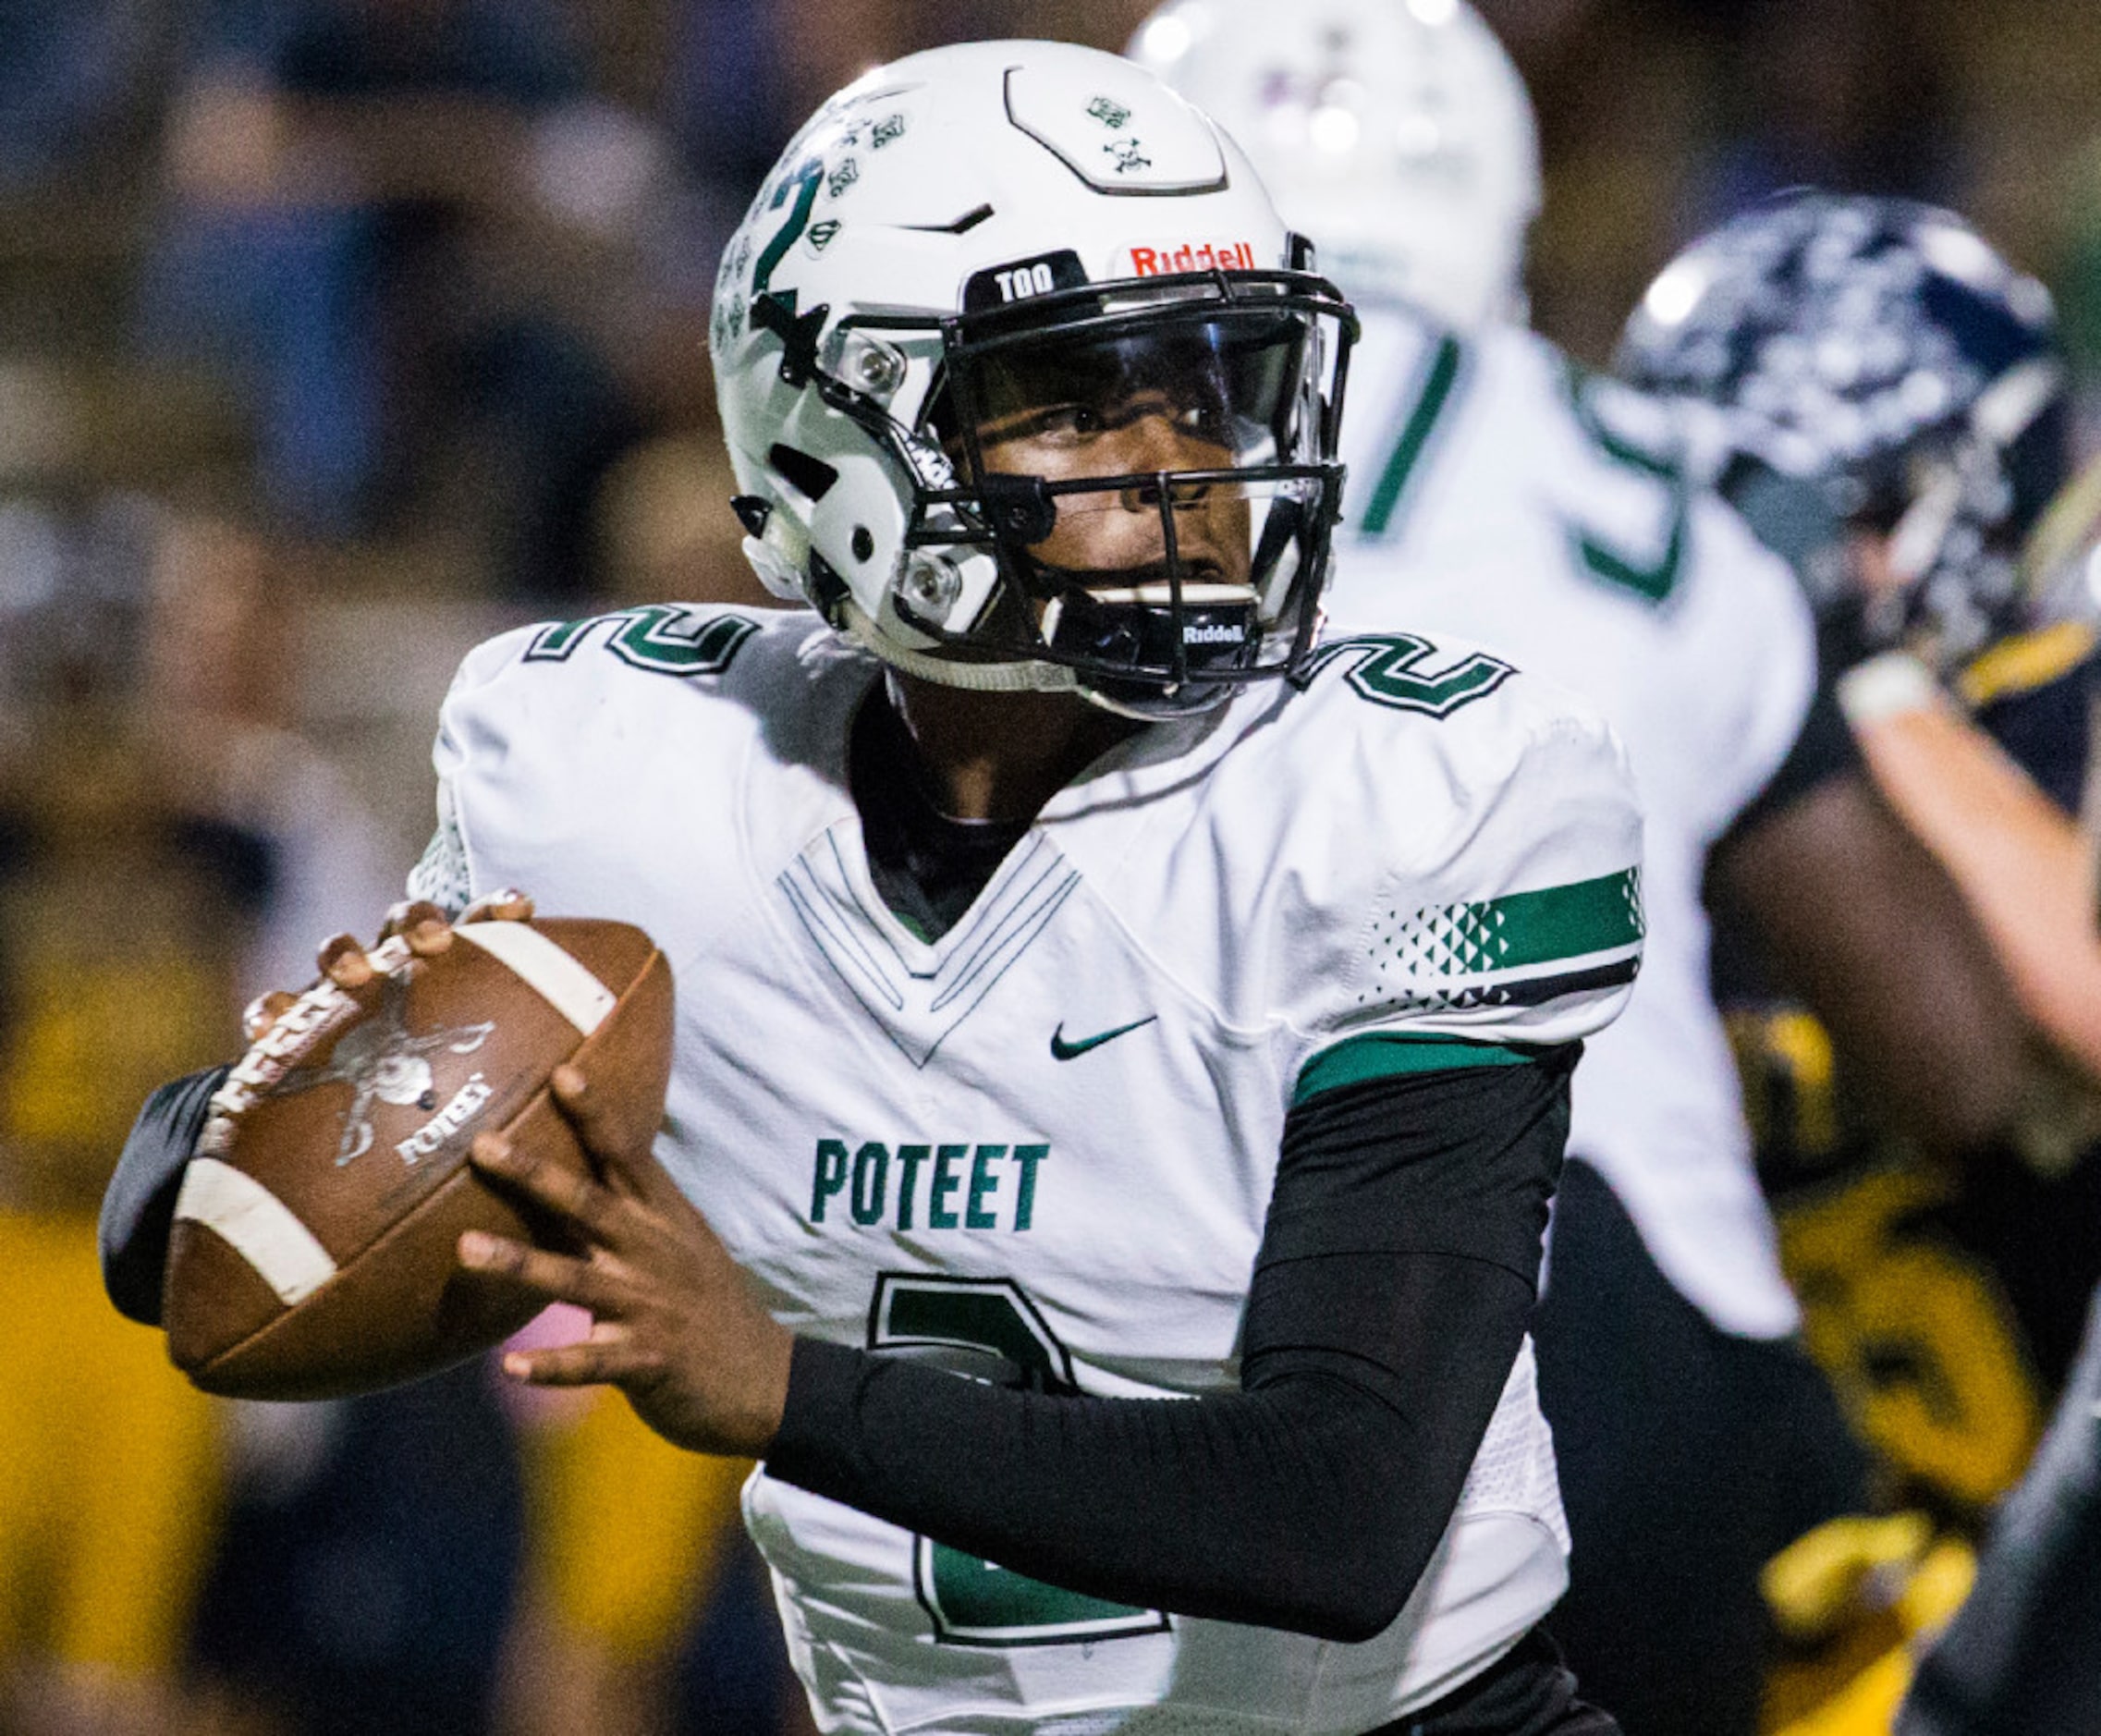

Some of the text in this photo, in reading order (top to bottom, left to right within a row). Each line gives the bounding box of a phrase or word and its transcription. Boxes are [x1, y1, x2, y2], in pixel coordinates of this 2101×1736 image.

[1183, 625, 1244, 643] Riddell
[1285, 632, 1521, 721] 2
[811, 1139, 1051, 1231] POTEET
